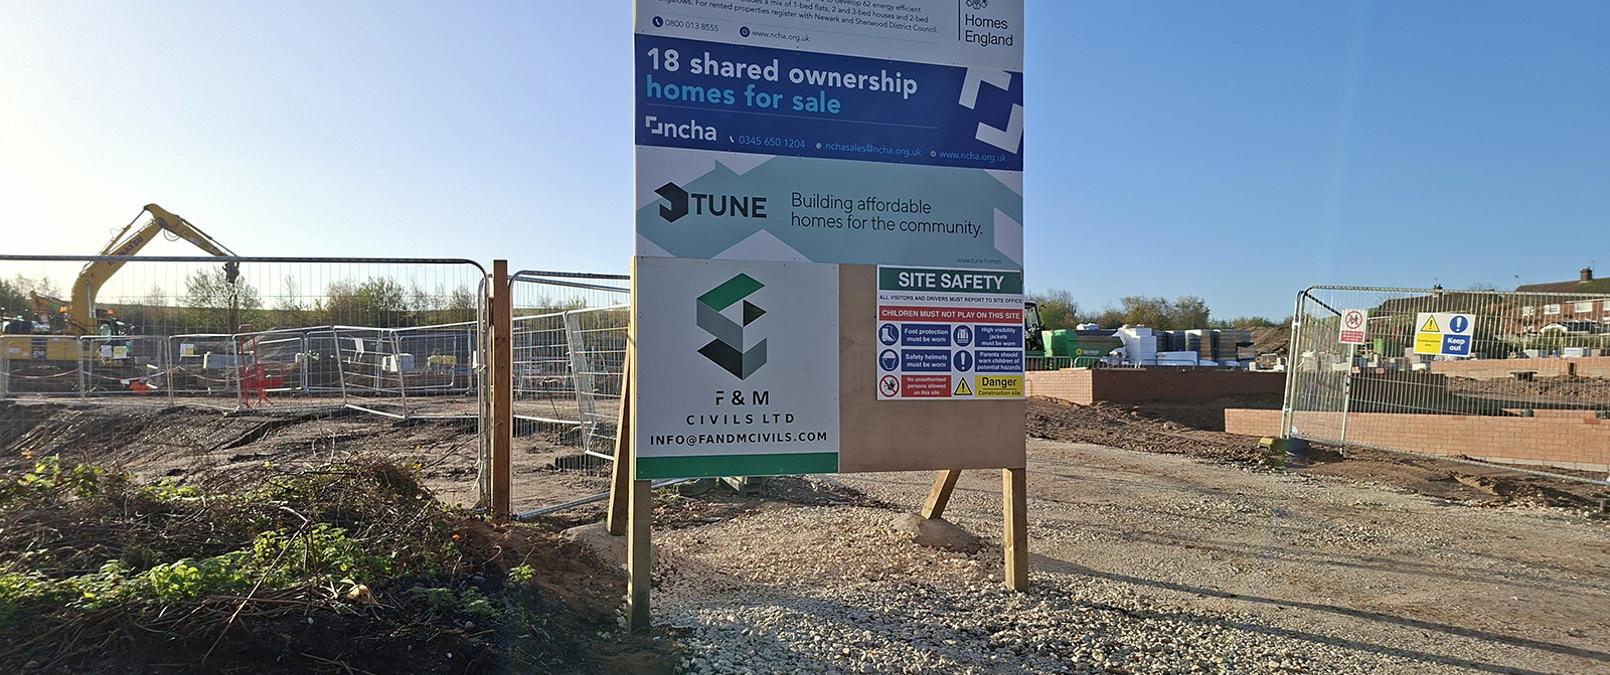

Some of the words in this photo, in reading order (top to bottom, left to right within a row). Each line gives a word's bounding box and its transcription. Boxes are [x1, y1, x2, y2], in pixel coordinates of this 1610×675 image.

[794, 1, 813, 9] 1-bed
[814, 4, 830, 12] flats,
[852, 8, 871, 16] 3-bed
[910, 15, 929, 23] 2-bed
[872, 3, 894, 11] energy
[896, 5, 922, 13] efficient
[665, 19, 684, 28] 0800
[685, 21, 699, 30] 013
[701, 23, 719, 32] 8555
[734, 6, 770, 15] properties
[771, 9, 798, 17] register
[855, 18, 888, 28] Sherwood
[889, 22, 912, 30] District
[965, 13, 1008, 30] Homes
[752, 30, 810, 42] www.ncha.org.uk
[965, 30, 1013, 47] England
[647, 47, 680, 72] 18
[690, 52, 779, 82] shared
[788, 67, 918, 100] ownership
[646, 74, 736, 105] homes
[744, 84, 784, 109] for
[792, 90, 841, 114] sale
[664, 119, 717, 141] ncha
[738, 135, 762, 145] 0345
[764, 137, 781, 147] 650
[784, 139, 805, 148] 1204
[825, 141, 922, 157] nchasales@ncha.org.uk
[939, 151, 1007, 163] www.ncha.org.uk
[691, 193, 768, 218] TUNE
[791, 192, 853, 213] Building
[857, 196, 932, 215] affordable
[791, 212, 843, 229] homes
[847, 213, 868, 229] for
[871, 216, 896, 231] the
[899, 219, 983, 238] community.
[898, 272, 936, 288] SITE
[940, 273, 1004, 290] SAFETY
[881, 309, 919, 317] CHILDREN
[920, 310, 940, 318] MUST
[1005, 312, 1021, 320] SITE
[1447, 337, 1466, 346] Keep
[982, 377, 1017, 389] Danger
[715, 390, 725, 406] F
[731, 390, 746, 406] &
[752, 391, 769, 406] M
[686, 414, 754, 426] CIVILS
[763, 414, 795, 424] LTD
[650, 432, 827, 446] INFO@FANDMCIVILS.COM
